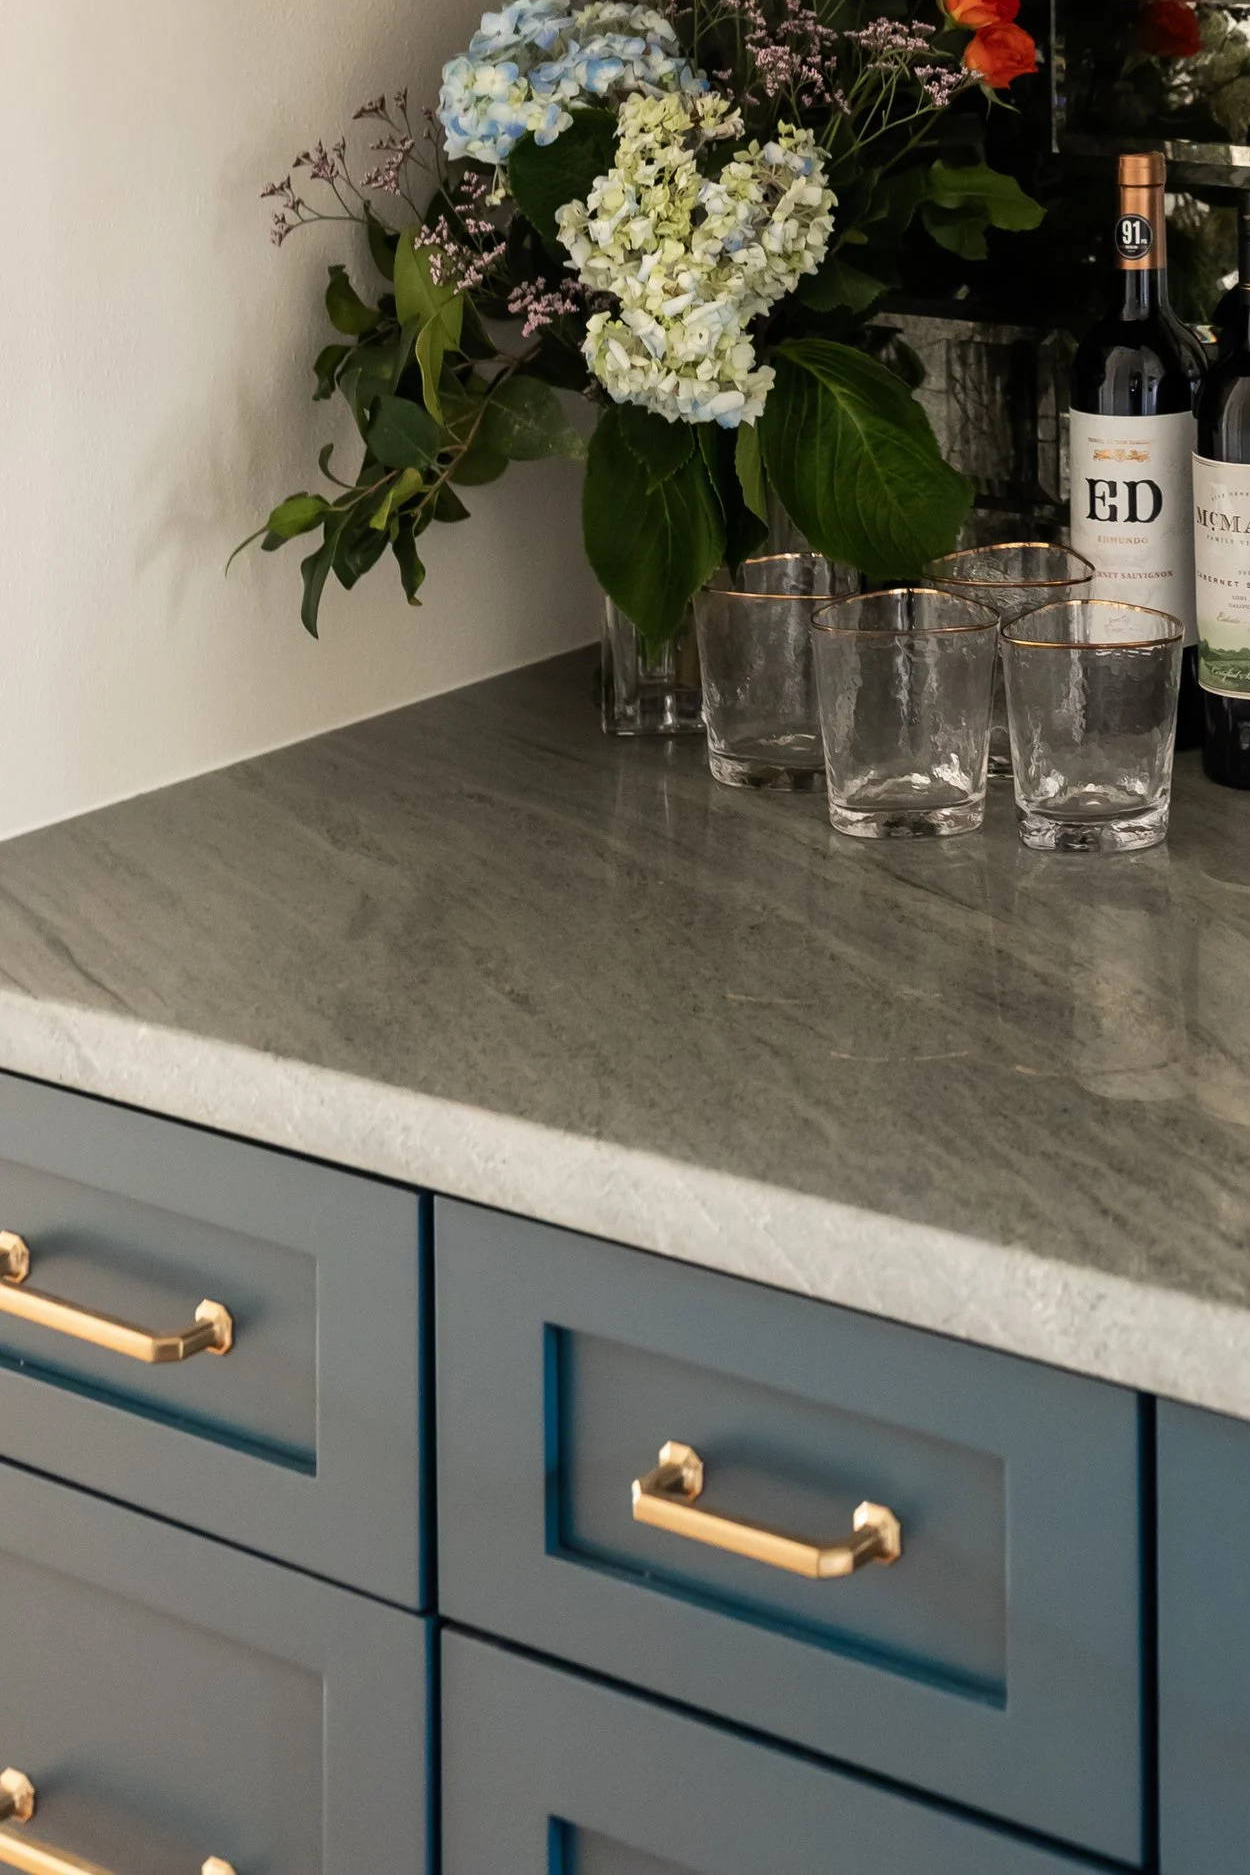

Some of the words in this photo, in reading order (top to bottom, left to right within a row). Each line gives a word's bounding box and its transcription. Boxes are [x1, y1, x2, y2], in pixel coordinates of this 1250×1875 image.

[1122, 220, 1140, 244] 91
[1085, 477, 1163, 524] ED
[1098, 535, 1150, 545] EDMUNDO
[1206, 534, 1235, 545] FAMILY
[1121, 570, 1174, 580] SAUVIGNON
